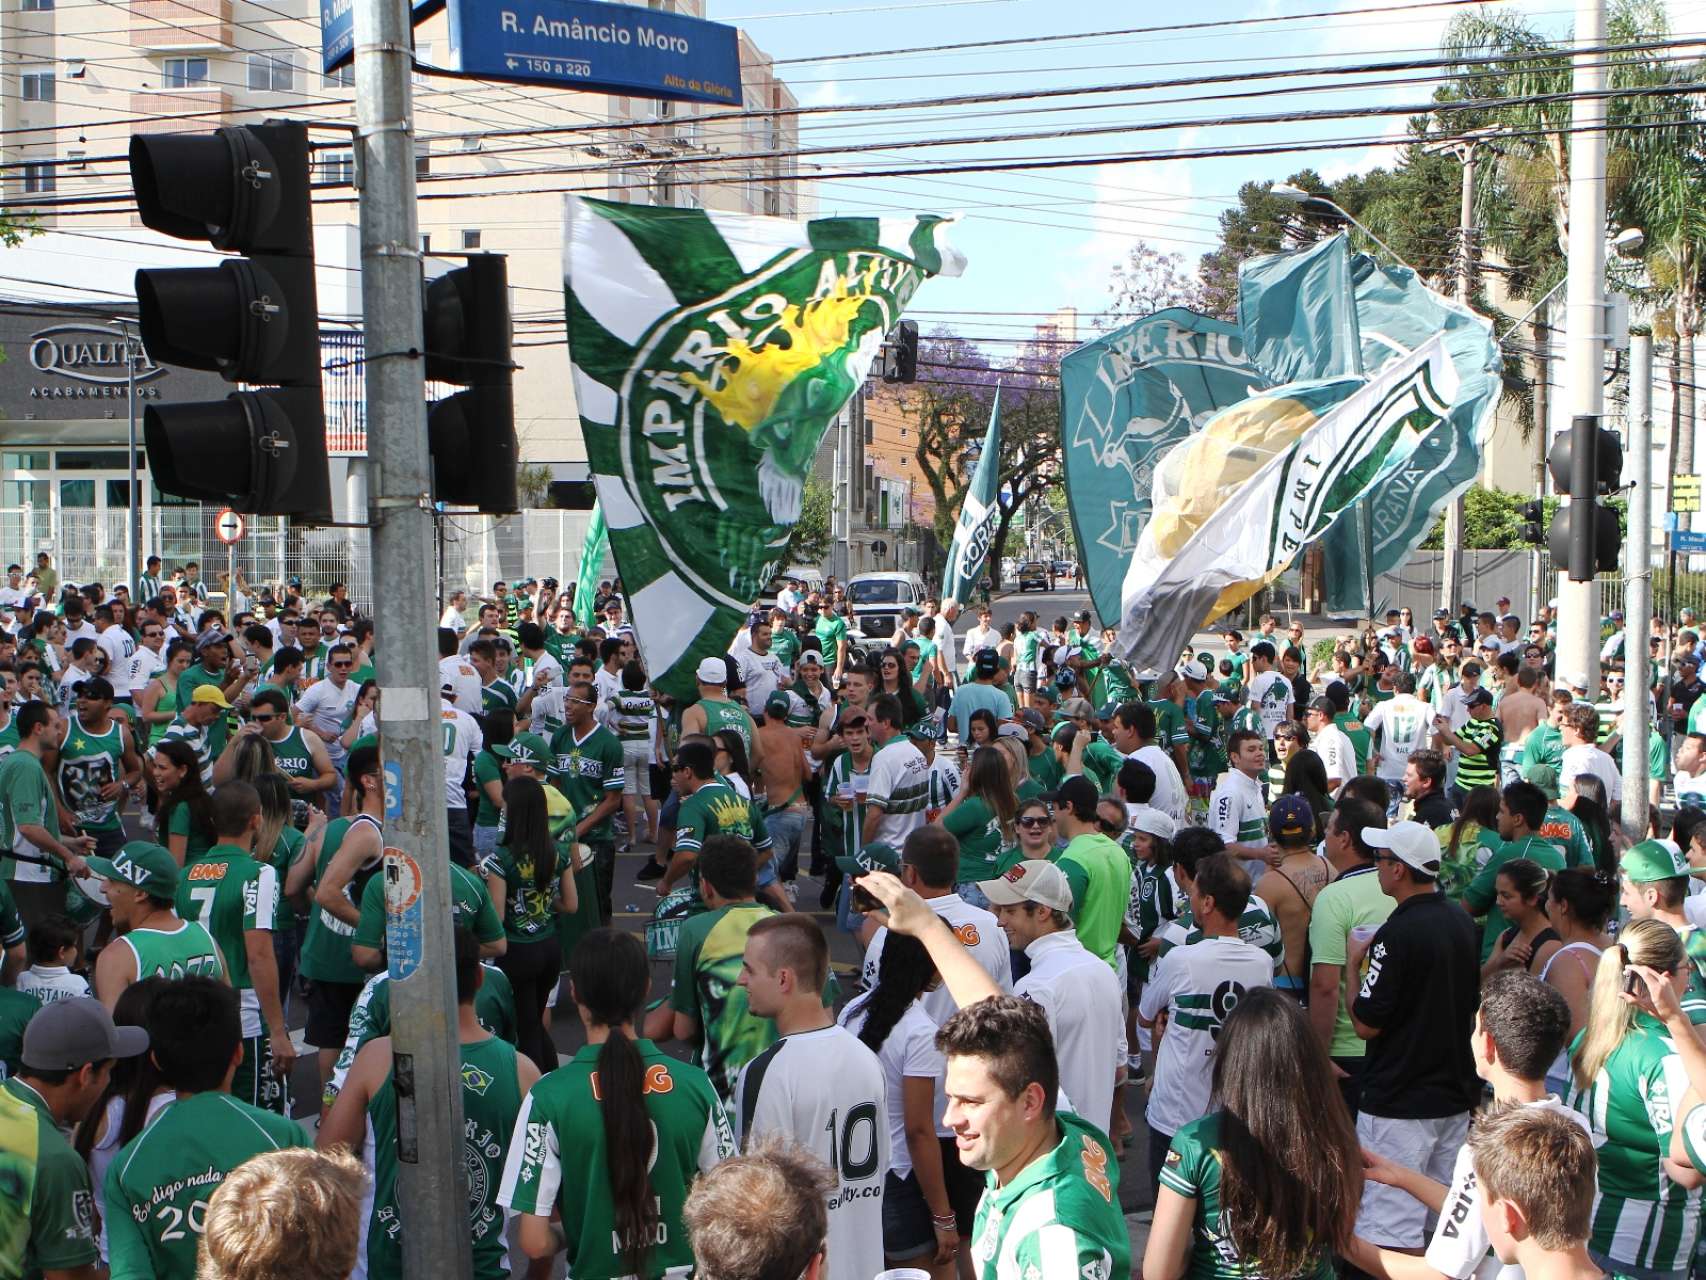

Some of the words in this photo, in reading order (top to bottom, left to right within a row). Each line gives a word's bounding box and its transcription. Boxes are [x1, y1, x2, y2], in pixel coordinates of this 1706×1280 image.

[501, 11, 525, 34] R.
[533, 15, 631, 45] Amâncio
[637, 26, 690, 55] Moro
[526, 59, 550, 73] 150
[555, 62, 562, 74] a
[566, 64, 591, 77] 220
[663, 73, 685, 89] Alto
[689, 78, 701, 91] da
[703, 80, 733, 98] Glória
[30, 386, 157, 397] ACABAMENOS
[1360, 958, 1383, 998] IRA
[523, 1122, 542, 1167] IRA
[187, 1166, 223, 1187] nada
[1441, 1191, 1473, 1240] IRA
